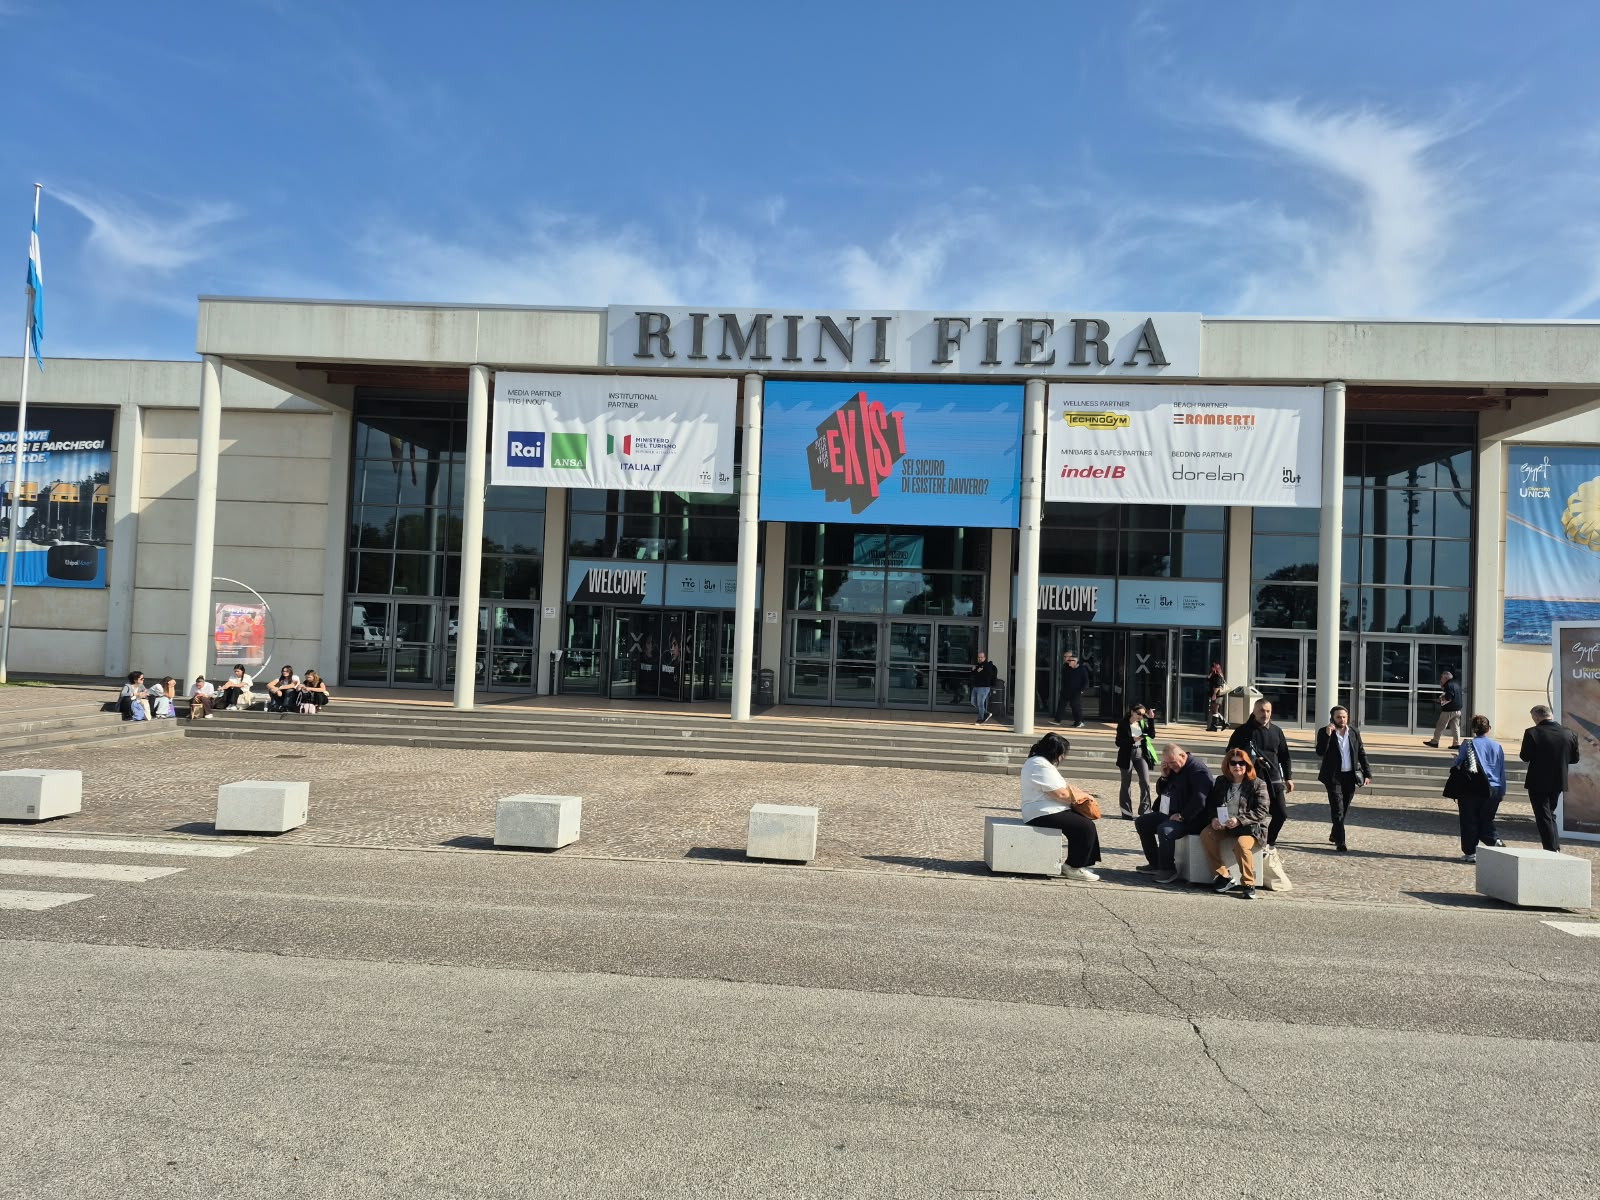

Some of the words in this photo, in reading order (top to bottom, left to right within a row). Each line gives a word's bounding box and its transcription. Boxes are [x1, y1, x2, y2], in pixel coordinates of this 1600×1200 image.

[633, 311, 892, 363] RIMINI
[932, 317, 1171, 366] FIERA
[507, 389, 530, 397] MEDIA
[530, 390, 562, 398] PARTNER
[608, 392, 659, 401] INSTITUTIONAL
[607, 401, 639, 409] PARTNER
[1185, 413, 1255, 426] RAMBERTI
[32, 442, 40, 452] E
[41, 440, 105, 451] PARCHEGGI
[826, 391, 906, 498] EXIST
[511, 441, 541, 458] Rai
[554, 458, 584, 467] ANSA
[1202, 451, 1233, 459] PARTNER
[620, 463, 661, 472] ITALIA.IT
[902, 459, 914, 476] SEI
[915, 459, 945, 477] SICURO
[1172, 463, 1245, 482] dorelan
[902, 477, 910, 493] DI
[911, 477, 947, 494] ESISTERE
[948, 478, 989, 496] DAVVERO?
[1282, 474, 1301, 484] out
[588, 568, 648, 595] WELCOME
[1037, 584, 1098, 612] WELCOME
